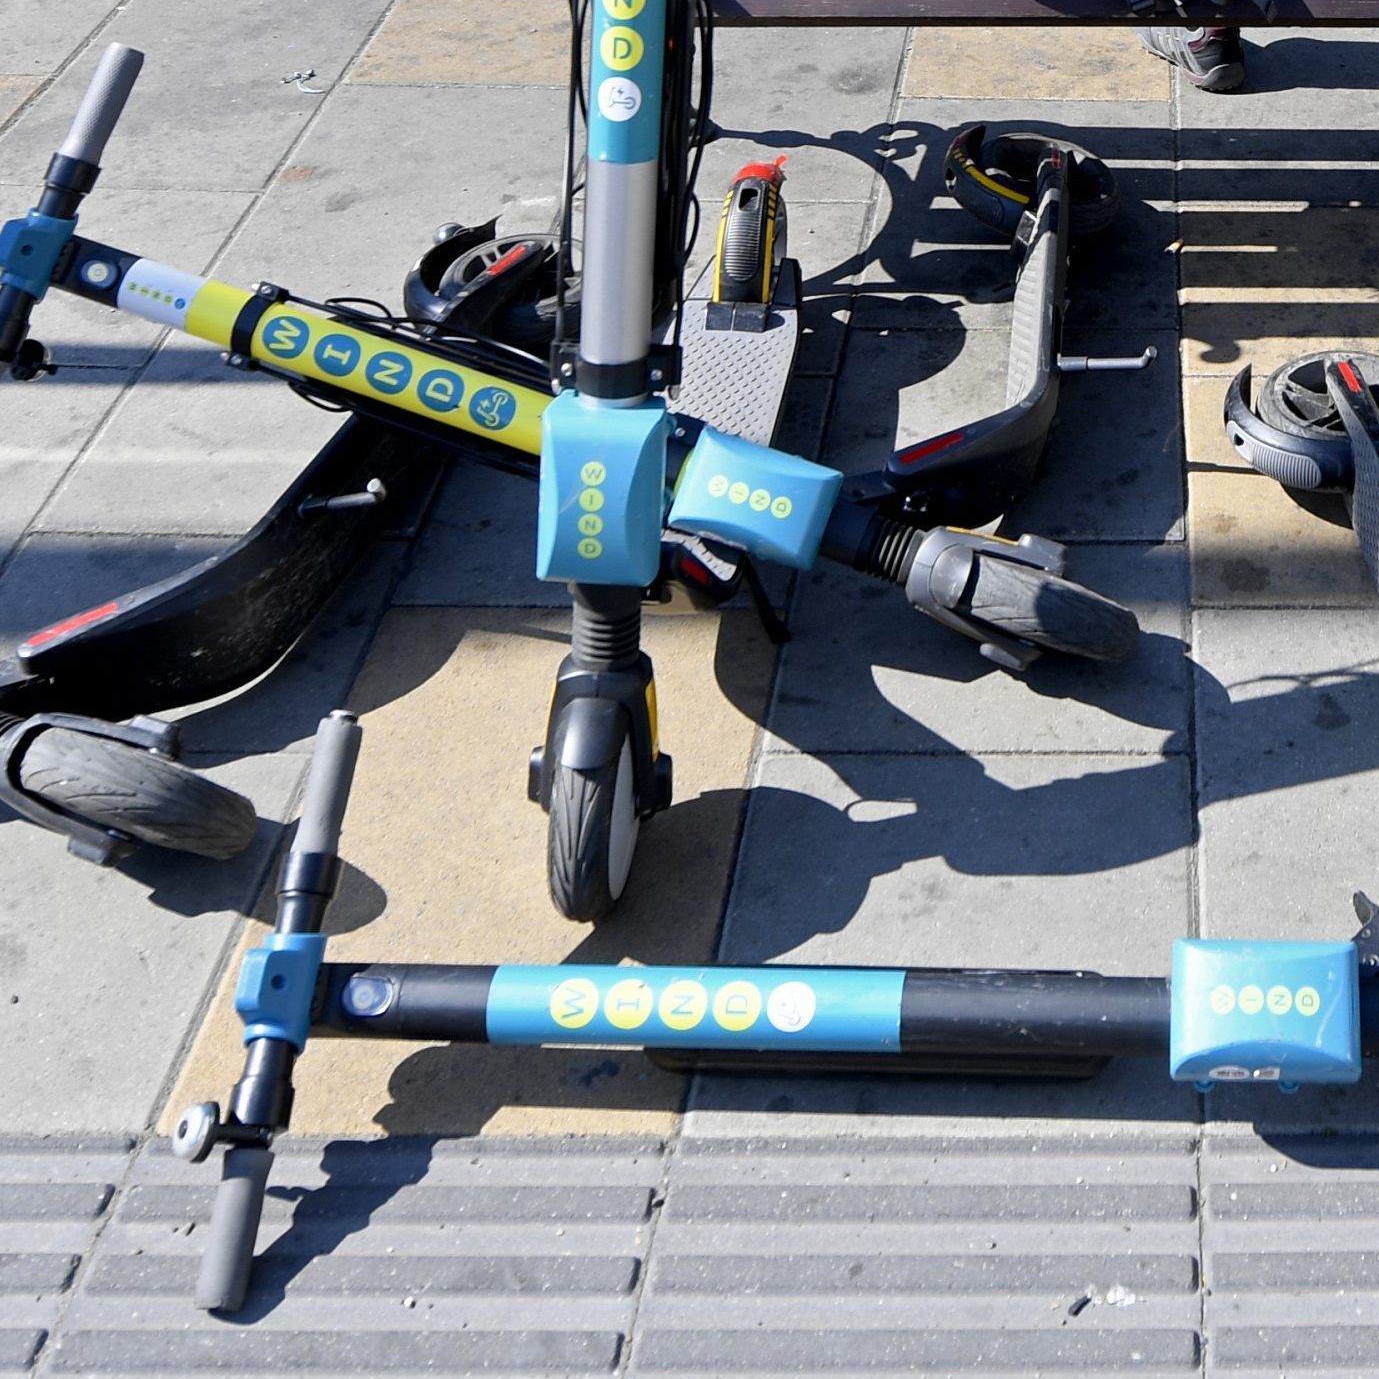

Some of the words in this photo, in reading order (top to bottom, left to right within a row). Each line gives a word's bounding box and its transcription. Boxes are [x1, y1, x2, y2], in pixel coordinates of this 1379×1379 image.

[267, 317, 455, 405] WIND
[581, 466, 604, 556] WIND
[711, 477, 789, 515] WIND
[559, 986, 749, 1020] WIND
[1215, 988, 1316, 1010] WIND
